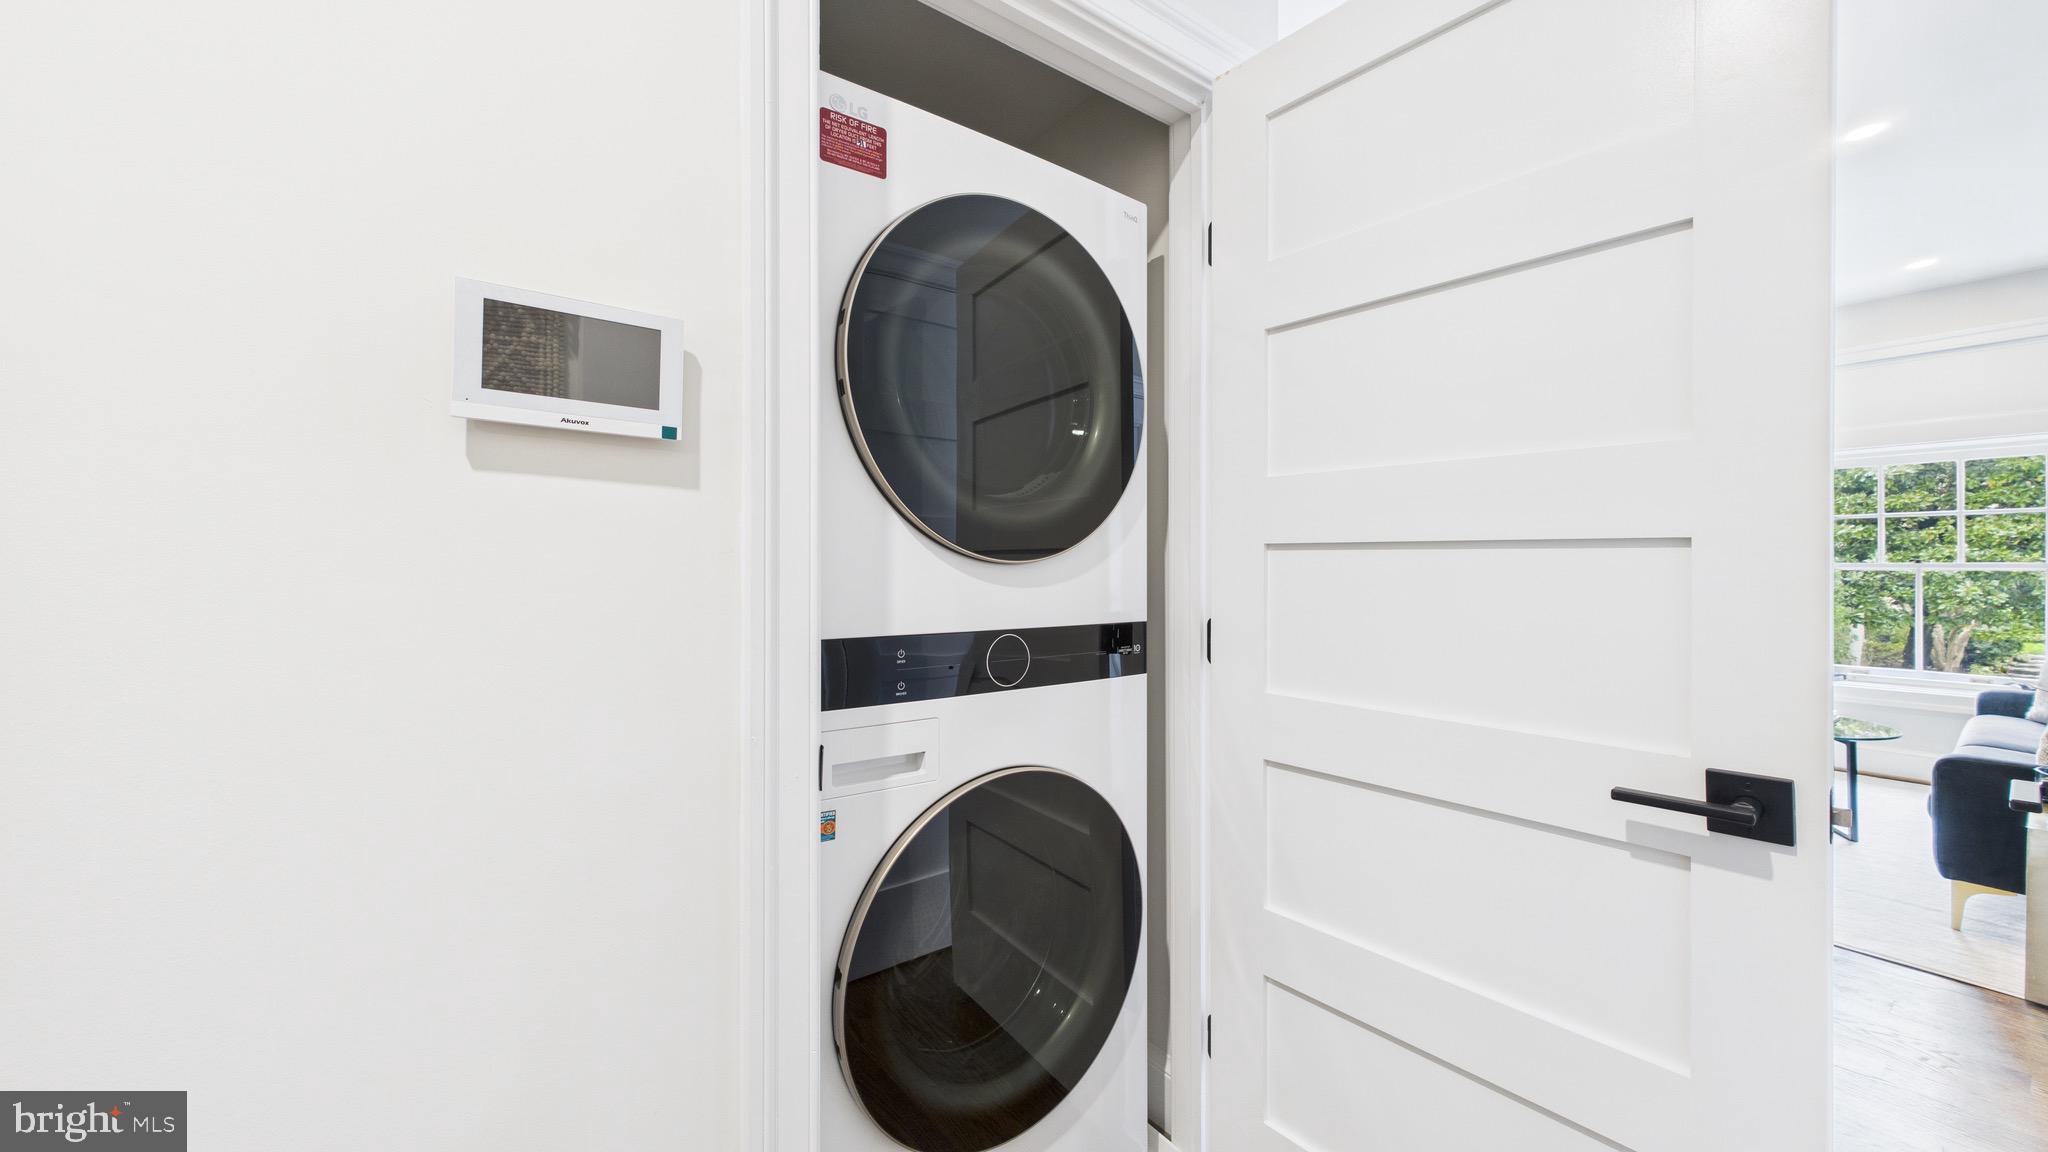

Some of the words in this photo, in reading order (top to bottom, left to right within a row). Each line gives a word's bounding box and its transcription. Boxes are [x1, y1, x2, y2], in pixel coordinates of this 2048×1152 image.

[830, 112, 847, 124] RISK
[849, 119, 859, 127] OF
[860, 123, 877, 134] FIRE
[560, 417, 589, 426] Akuvox
